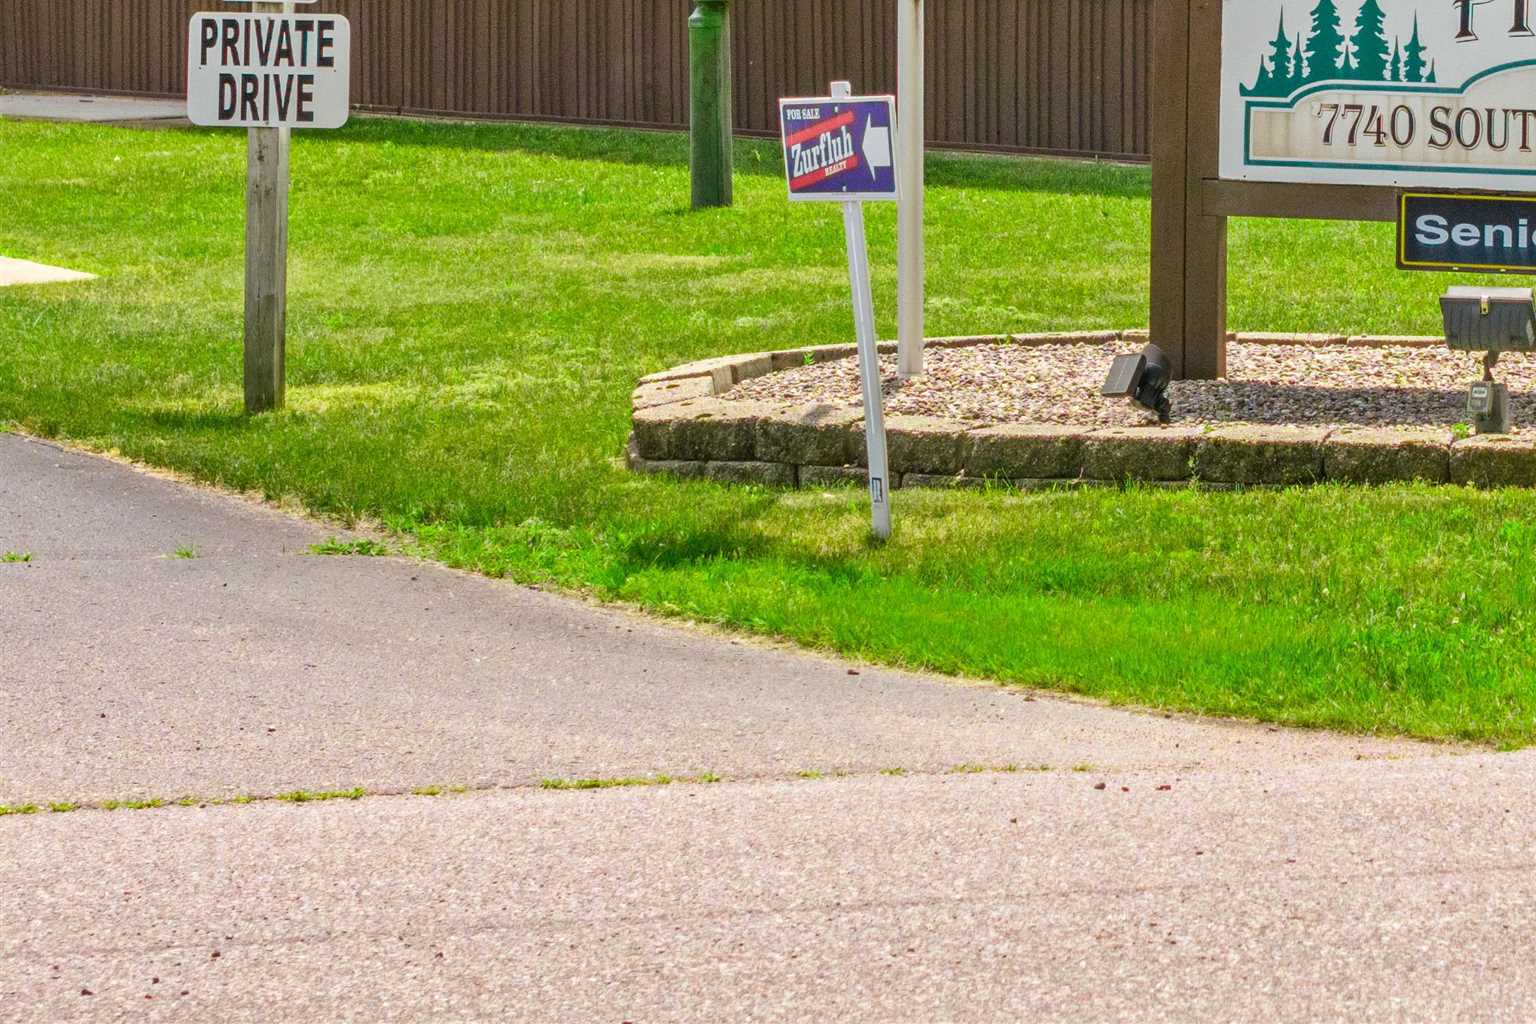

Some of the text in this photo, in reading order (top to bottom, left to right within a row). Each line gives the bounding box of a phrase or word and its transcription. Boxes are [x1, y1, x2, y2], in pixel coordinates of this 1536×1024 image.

[200, 18, 335, 68] PRIVATE
[218, 72, 315, 123] DRIVE
[786, 107, 820, 120] FOR SALE
[1317, 103, 1416, 149] 7740
[791, 125, 855, 178] Zurfluh
